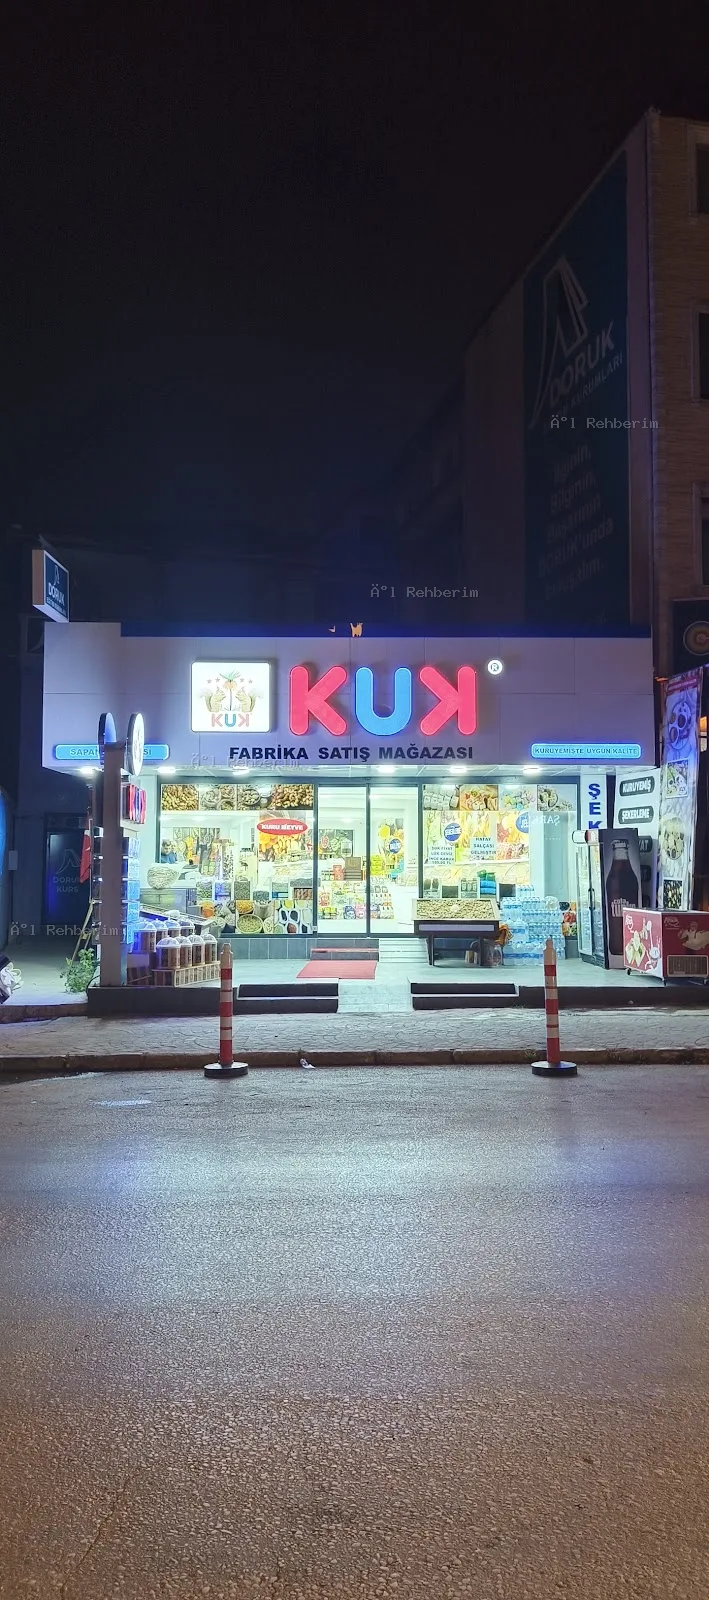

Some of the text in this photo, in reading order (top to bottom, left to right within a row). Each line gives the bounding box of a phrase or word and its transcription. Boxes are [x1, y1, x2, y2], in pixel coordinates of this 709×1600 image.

[550, 318, 615, 408] DORUK
[289, 665, 477, 736] KUK
[211, 713, 250, 728] KUK
[229, 742, 473, 762] FABRİKA SATIŞ MAĞAZASI
[534, 747, 584, 756] KURUYEMİŞTE
[612, 747, 638, 755] KALİTE
[622, 777, 652, 794] KURUYEMİŞ
[621, 808, 650, 823] ŞEKERLEME
